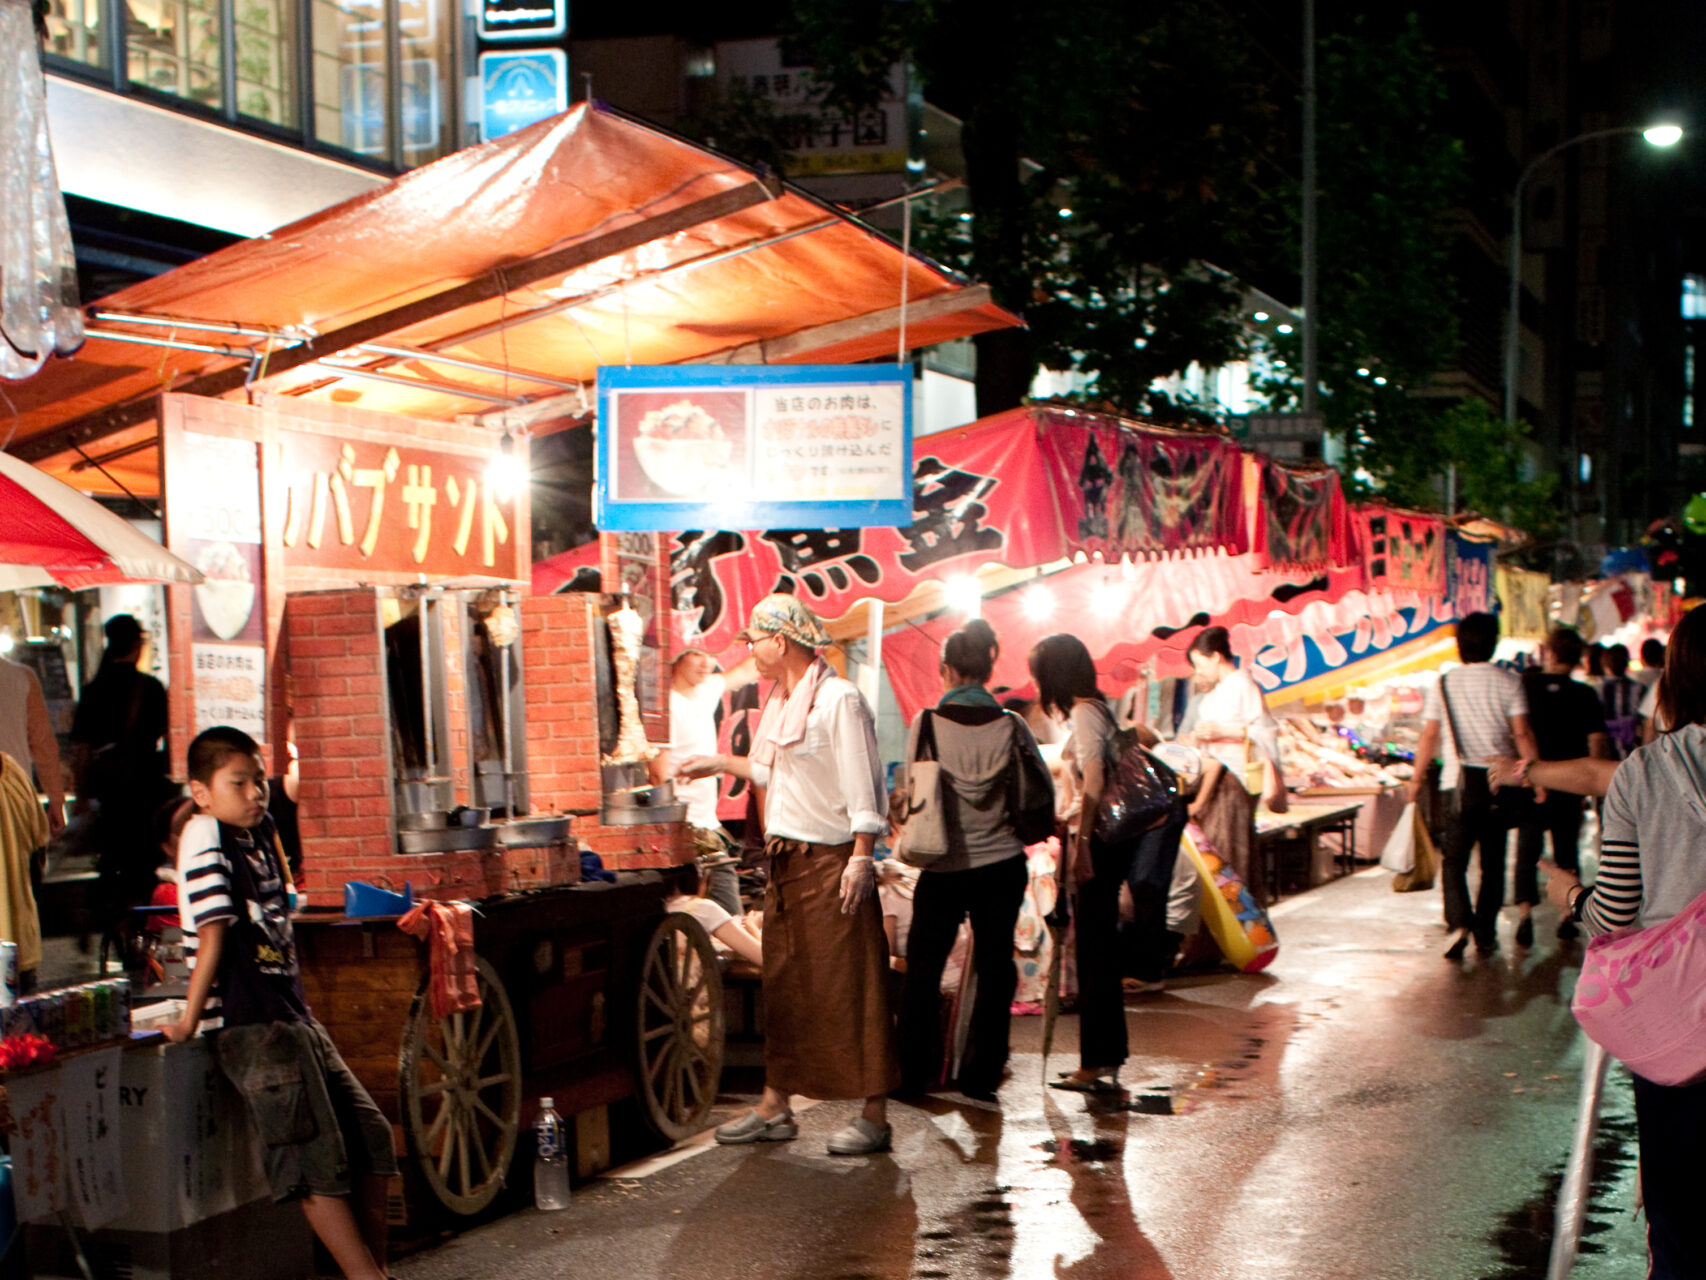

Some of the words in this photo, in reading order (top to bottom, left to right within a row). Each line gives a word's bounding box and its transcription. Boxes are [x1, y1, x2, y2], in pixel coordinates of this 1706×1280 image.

[279, 441, 511, 568] バブサンド
